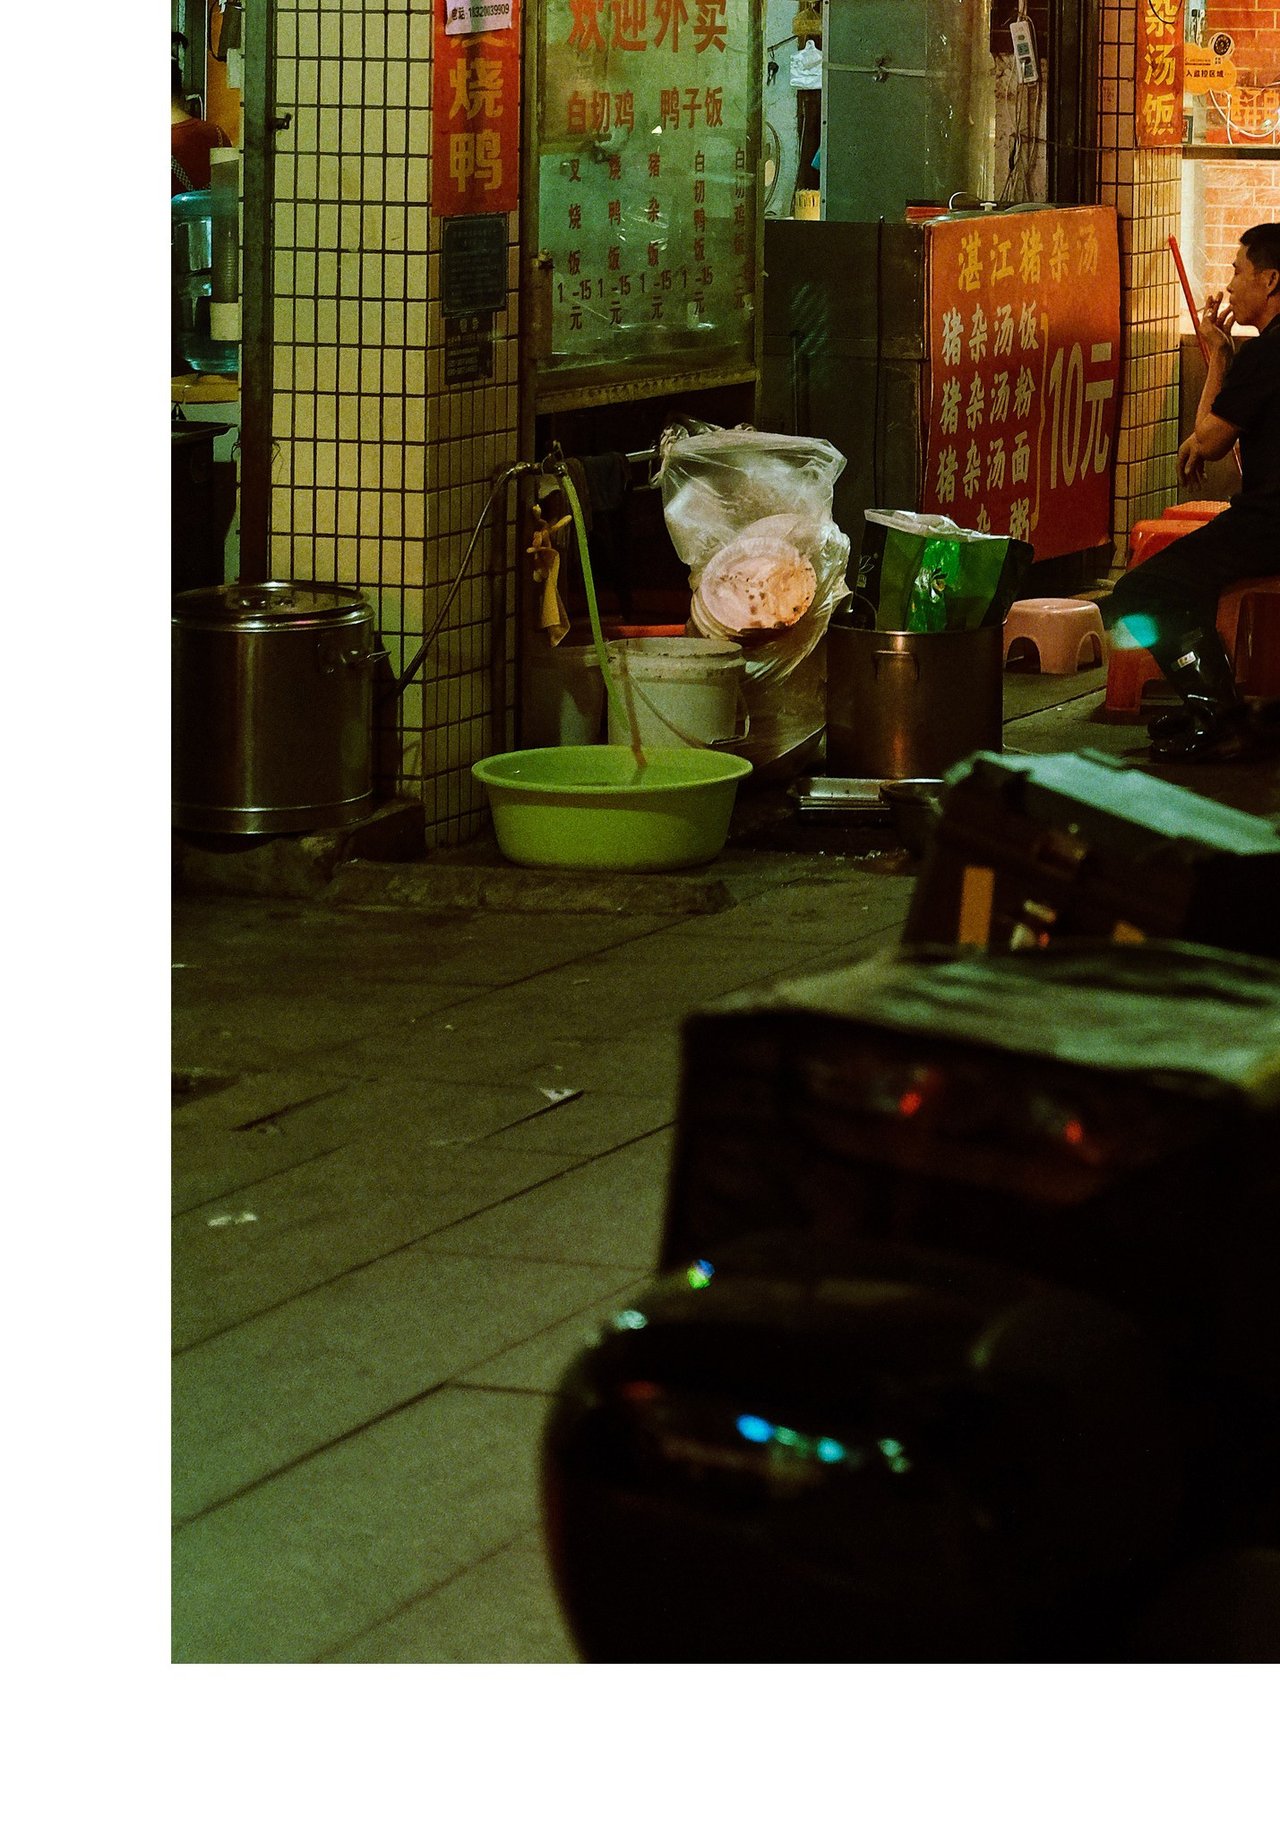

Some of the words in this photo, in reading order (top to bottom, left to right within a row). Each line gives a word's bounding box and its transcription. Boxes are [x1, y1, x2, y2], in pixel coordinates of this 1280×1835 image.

[566, 90, 635, 135] 白切鸡
[660, 86, 724, 131] 鸭子饭
[957, 221, 1100, 293] 湛江猪杂汤
[940, 300, 1040, 367] 猪杂汤饭
[939, 364, 1037, 435] 猪杂汤粉
[1048, 341, 1114, 490] 10元
[934, 430, 1032, 504] 猪杂汤面
